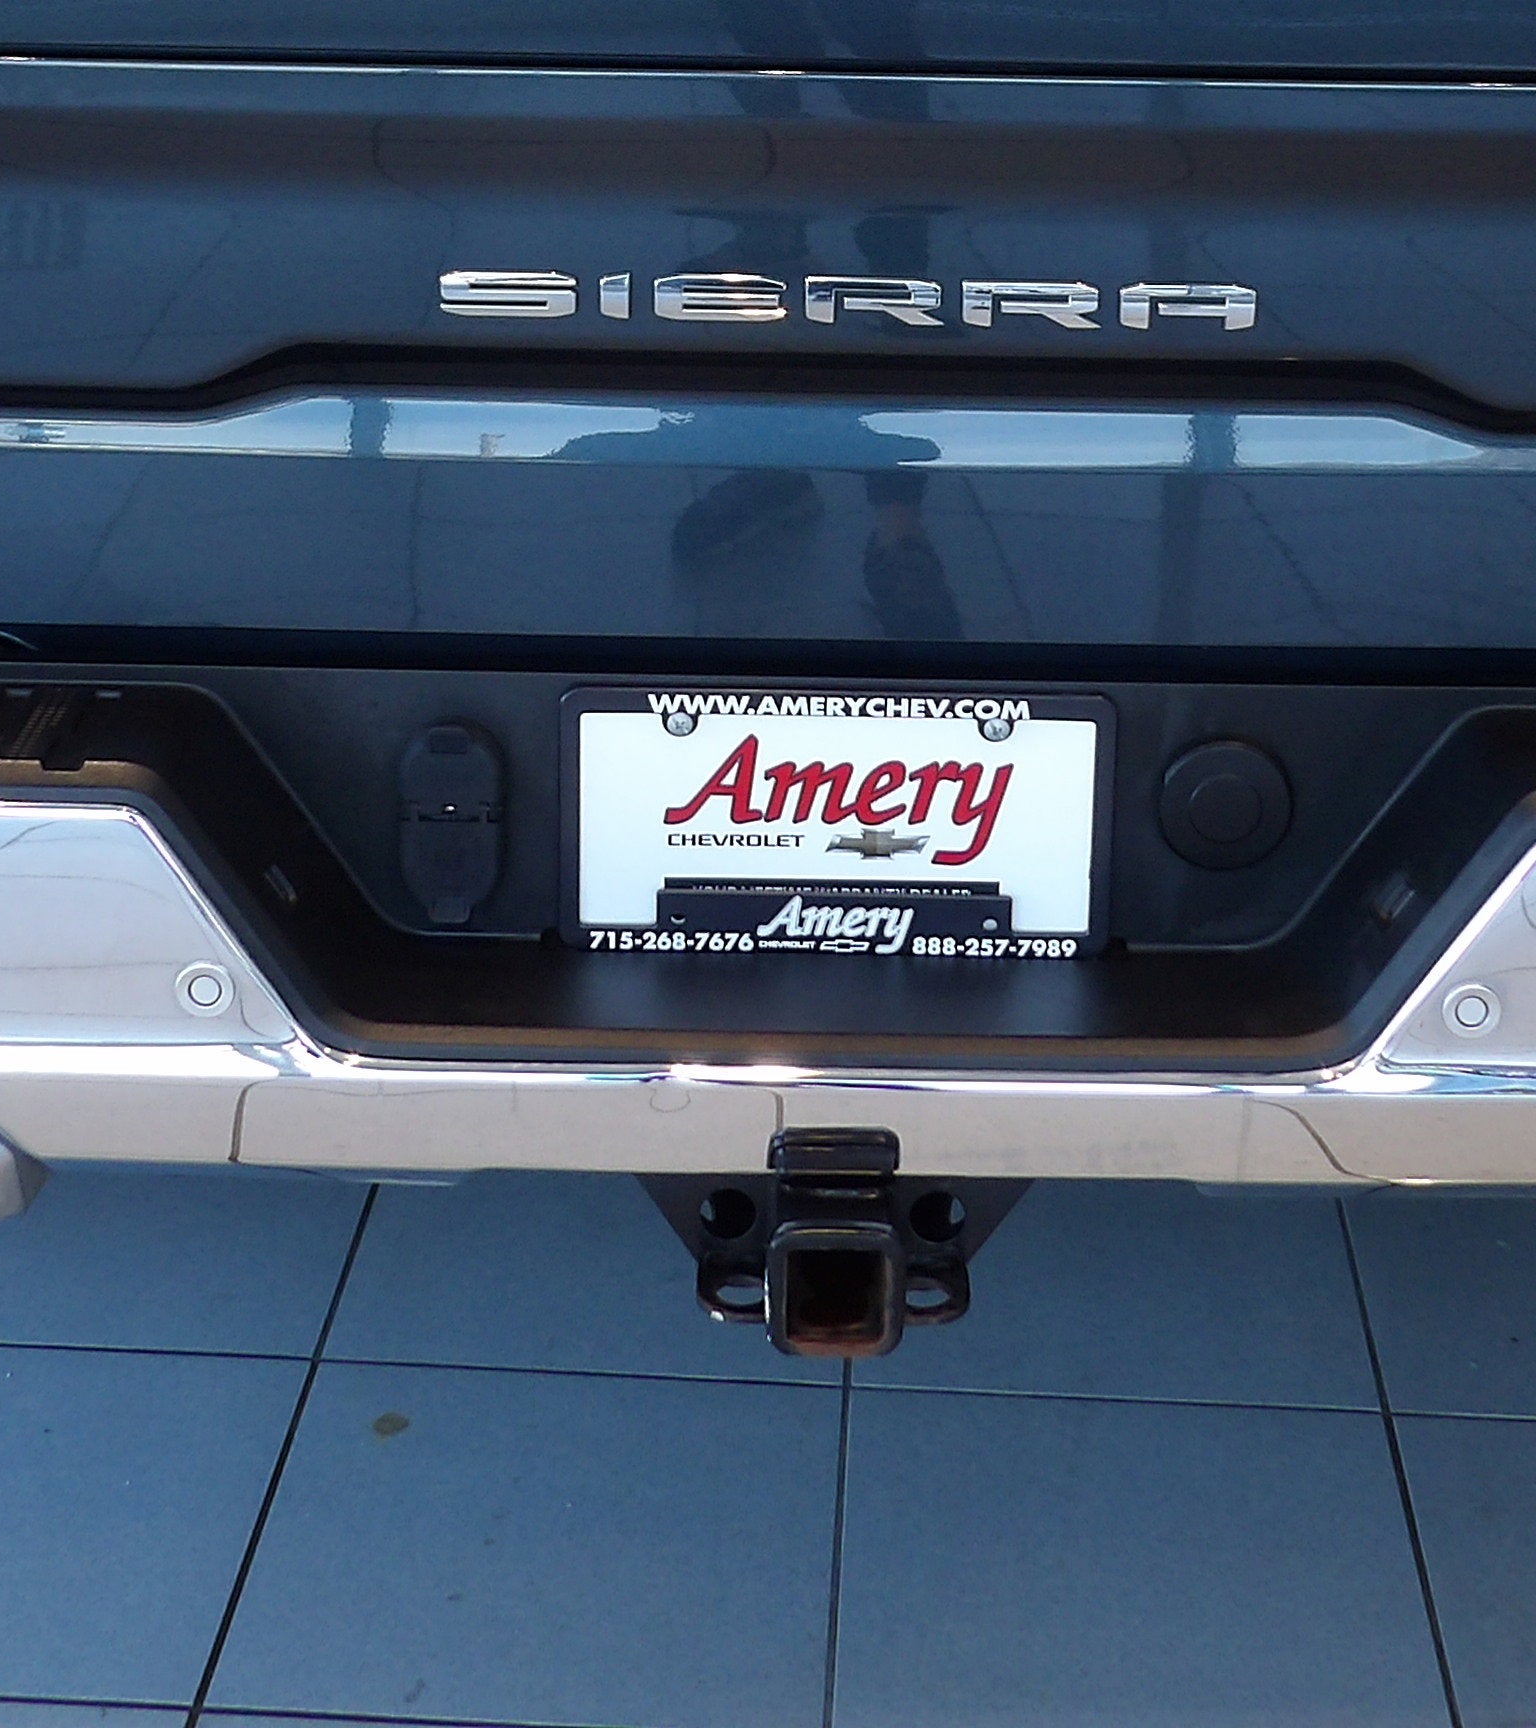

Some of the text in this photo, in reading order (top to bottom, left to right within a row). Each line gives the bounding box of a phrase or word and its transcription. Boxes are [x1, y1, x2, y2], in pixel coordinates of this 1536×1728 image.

[439, 271, 1257, 331] SIERRA
[648, 693, 1031, 720] WWW.AMERYCHEV.COM
[664, 733, 1014, 865] Amery
[667, 833, 805, 849] CHEVROLET
[757, 894, 914, 954] Amery
[589, 930, 754, 952] 715-268-7676
[759, 940, 816, 950] CHEVROLET
[912, 936, 1077, 958] 888-257-7989
